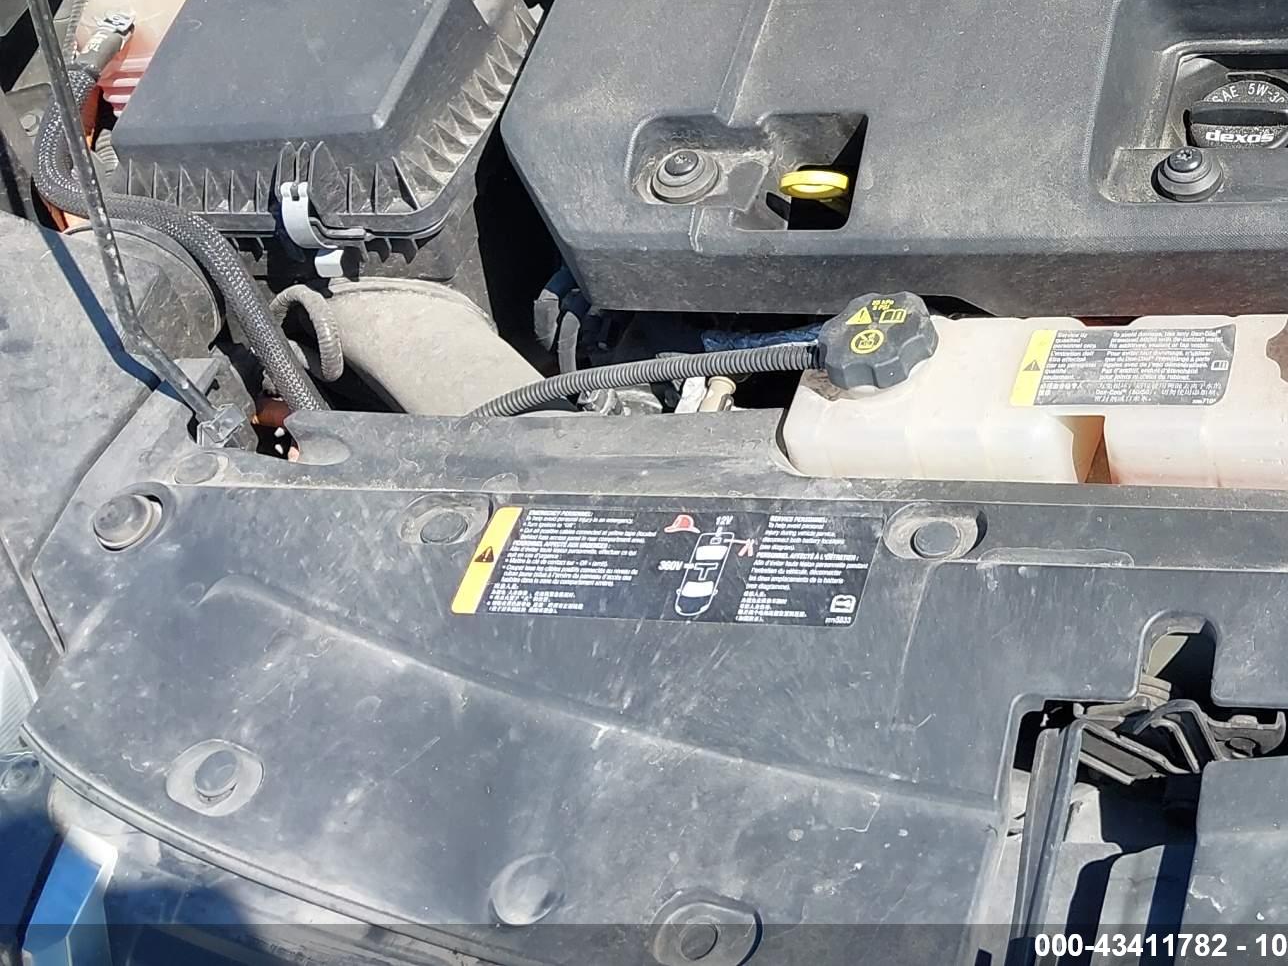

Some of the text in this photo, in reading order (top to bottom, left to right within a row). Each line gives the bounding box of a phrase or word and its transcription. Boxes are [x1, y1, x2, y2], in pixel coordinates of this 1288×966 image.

[1211, 85, 1239, 103] SAE
[1205, 129, 1275, 143] dexos
[716, 515, 733, 525] 12V
